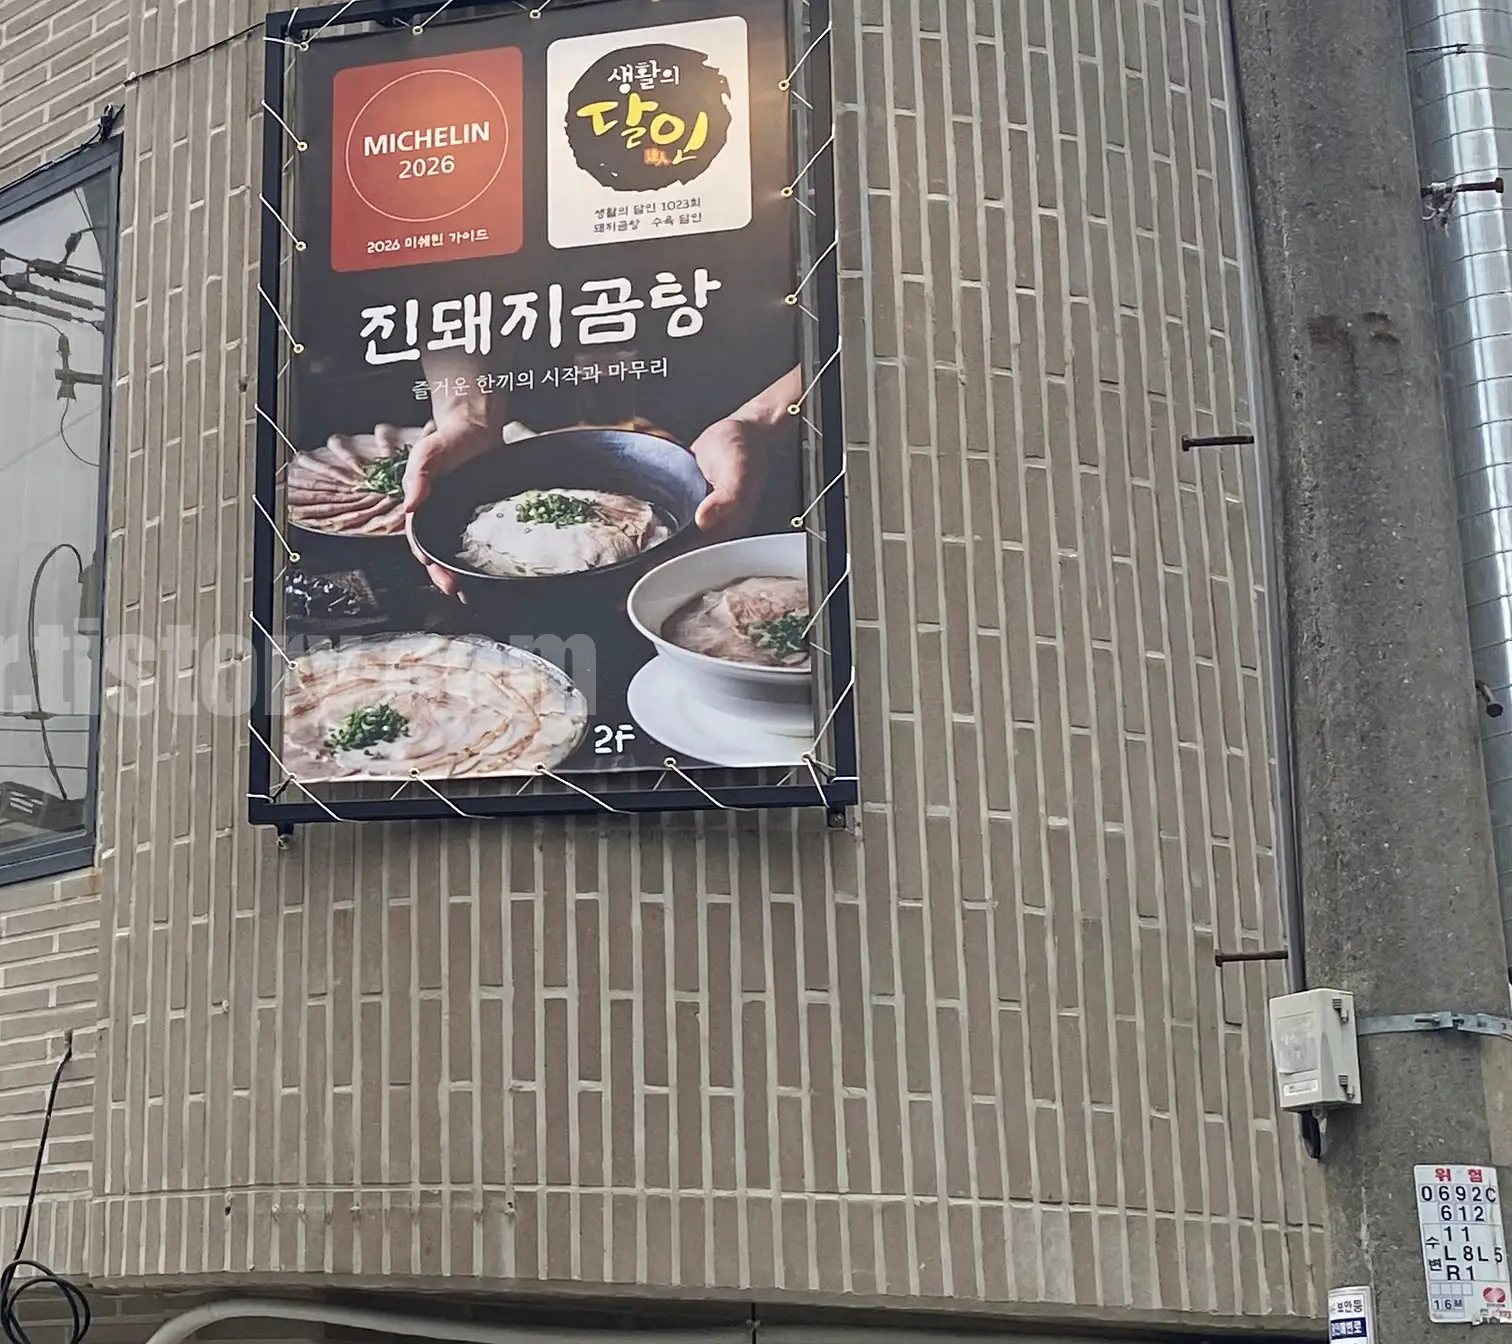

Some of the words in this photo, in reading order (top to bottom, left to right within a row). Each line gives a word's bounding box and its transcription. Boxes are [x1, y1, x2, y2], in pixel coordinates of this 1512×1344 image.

[607, 59, 680, 94] 생활의
[364, 121, 490, 157] MICHELIN
[576, 92, 709, 166] 달인
[398, 154, 456, 179] 2026
[594, 205, 629, 219] 생활의
[633, 202, 656, 215] 달인
[661, 197, 701, 211] 1023회
[367, 239, 401, 254] 2026
[448, 229, 490, 244] 가이드
[359, 268, 722, 366] 진돼지곰탕
[411, 376, 471, 401] 즐거운
[476, 369, 535, 394] 한끼의
[541, 363, 602, 388] 시작과
[608, 357, 669, 381] 마무리
[593, 723, 635, 755] 2F
[1440, 1205, 1485, 1222] 612
